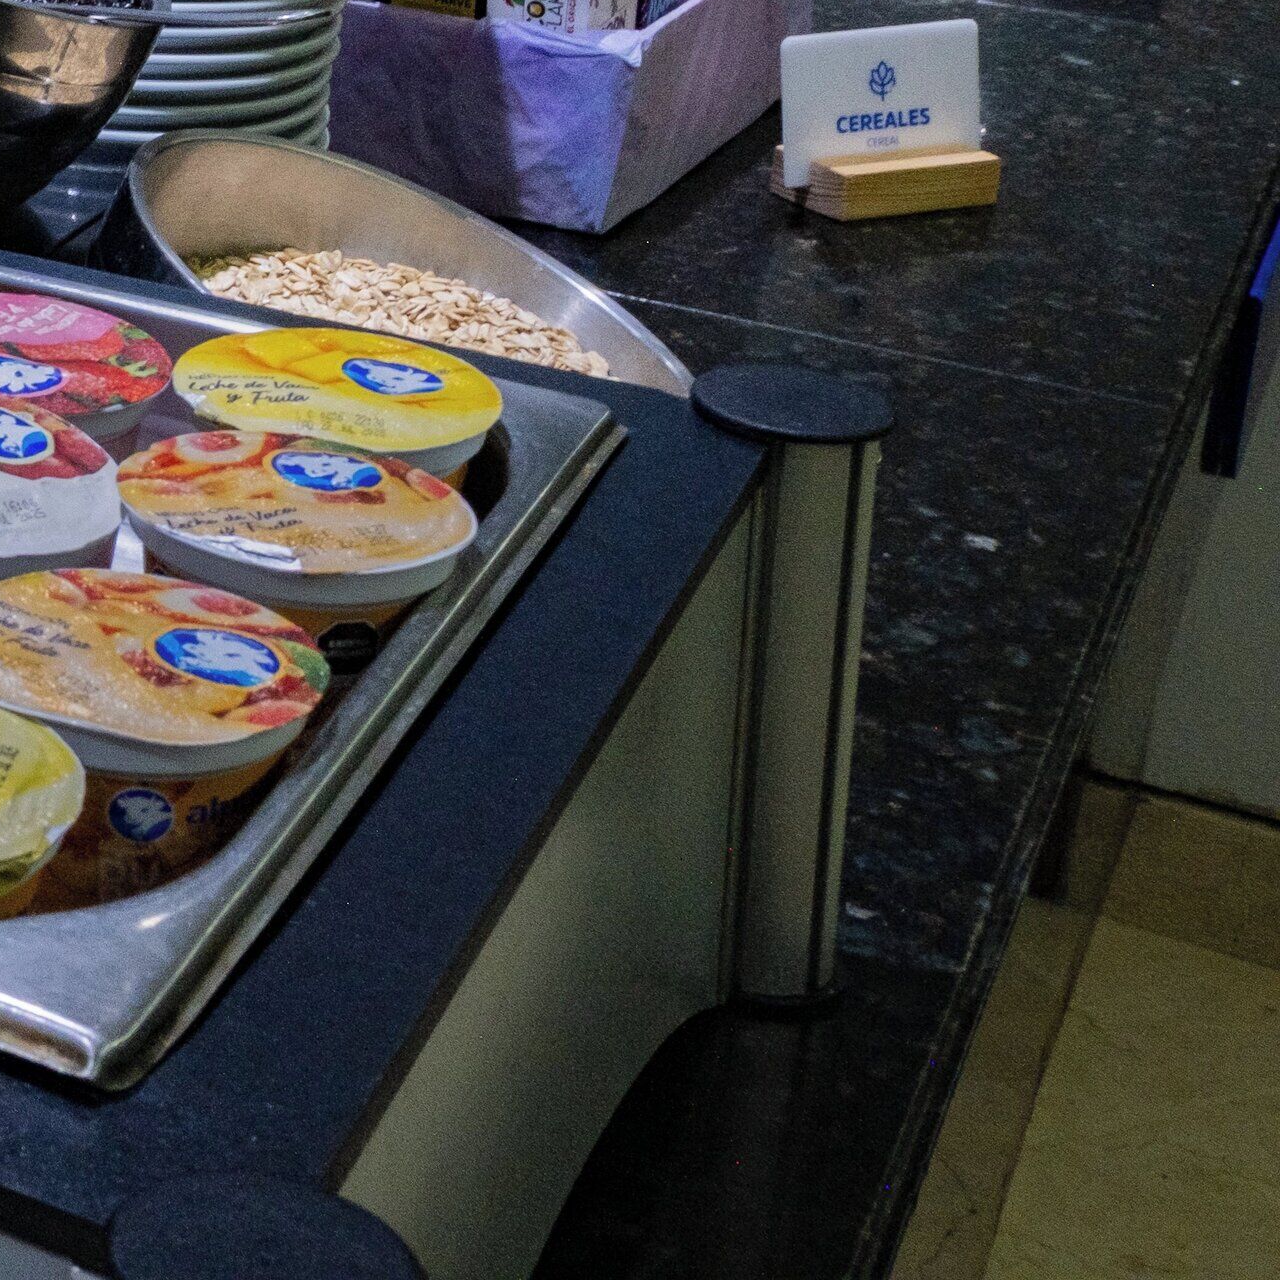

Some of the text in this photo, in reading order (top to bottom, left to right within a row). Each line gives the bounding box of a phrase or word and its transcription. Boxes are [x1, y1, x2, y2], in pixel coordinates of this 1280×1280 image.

[836, 107, 931, 134] CEREALES
[188, 380, 239, 392] Leche
[244, 381, 267, 389] de
[226, 390, 311, 405] y Fruta
[4, 636, 59, 658] Fruta
[48, 632, 91, 650] Vaca
